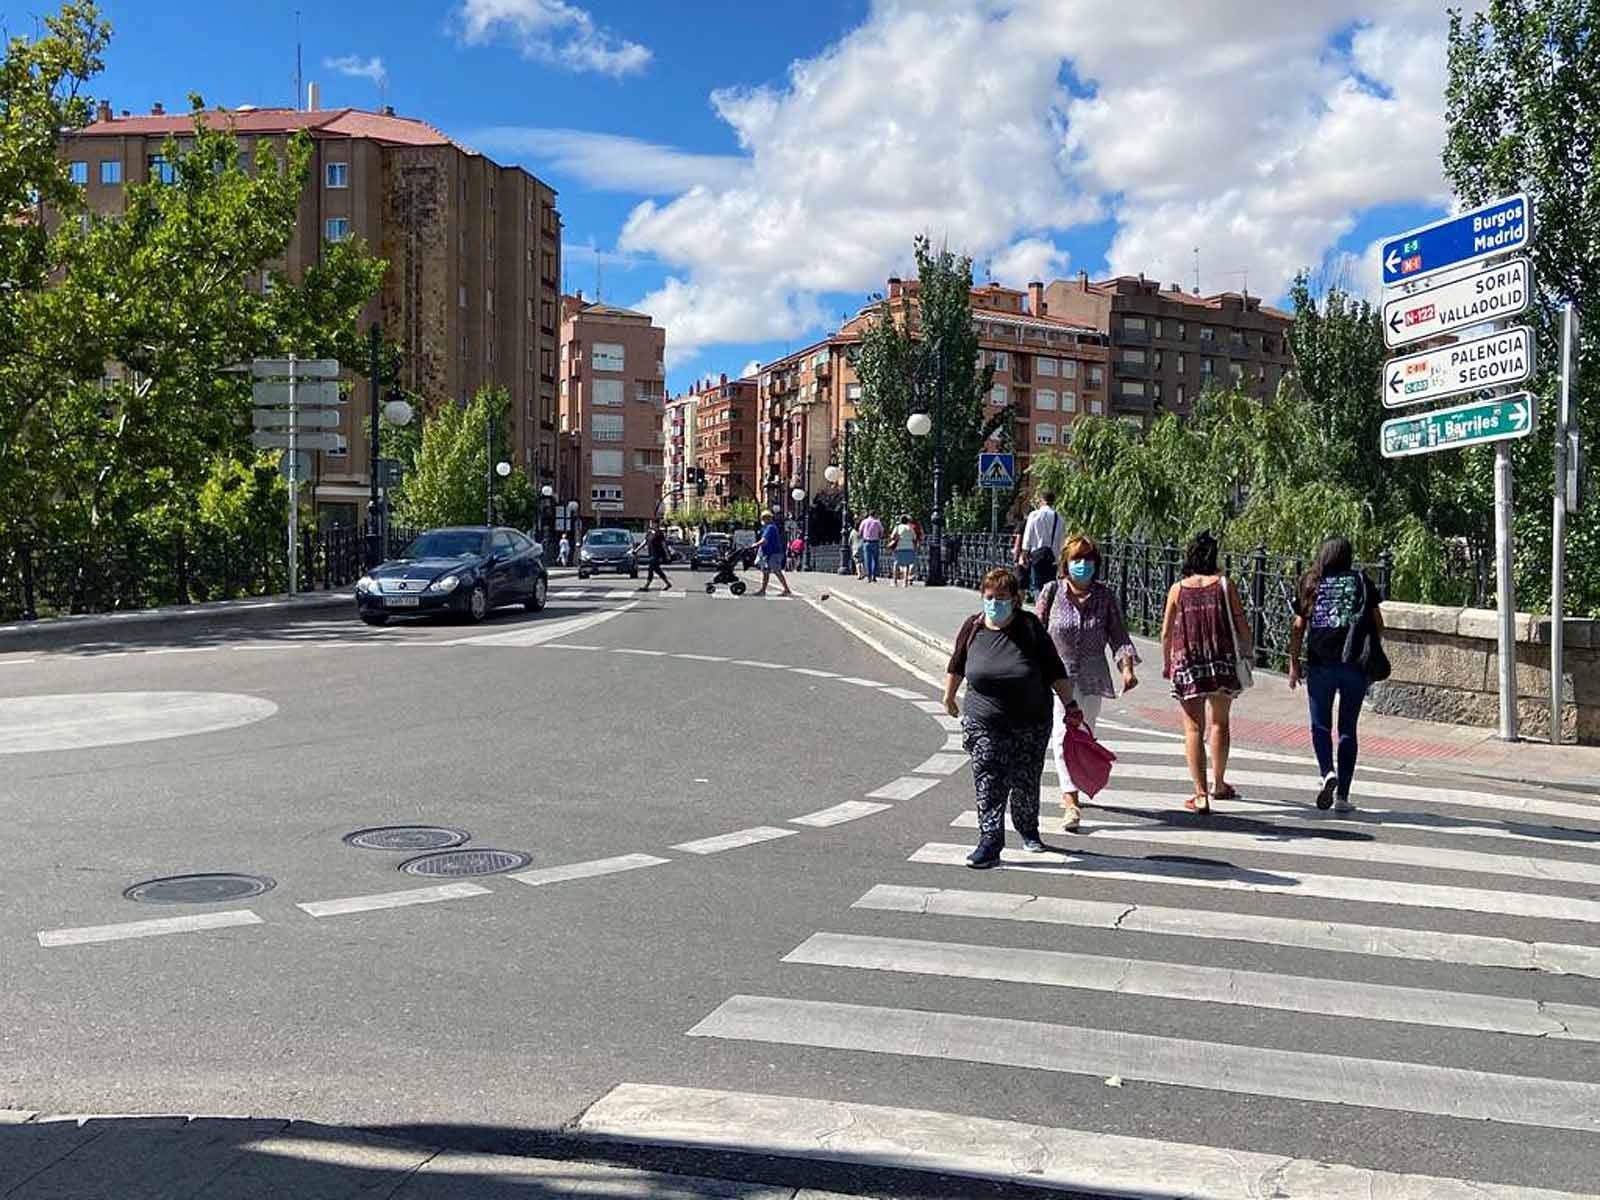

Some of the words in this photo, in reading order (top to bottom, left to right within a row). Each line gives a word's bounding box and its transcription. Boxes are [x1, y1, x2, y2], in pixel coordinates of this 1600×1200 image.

[1473, 206, 1522, 232] Burgos
[1474, 224, 1523, 252] Madrid
[1475, 269, 1522, 294] SORIA
[1439, 290, 1523, 325] VALLADOLID
[1451, 337, 1523, 366] PALENCIA
[1459, 357, 1524, 383] SEGOVIA
[1445, 416, 1499, 435] Barriles
